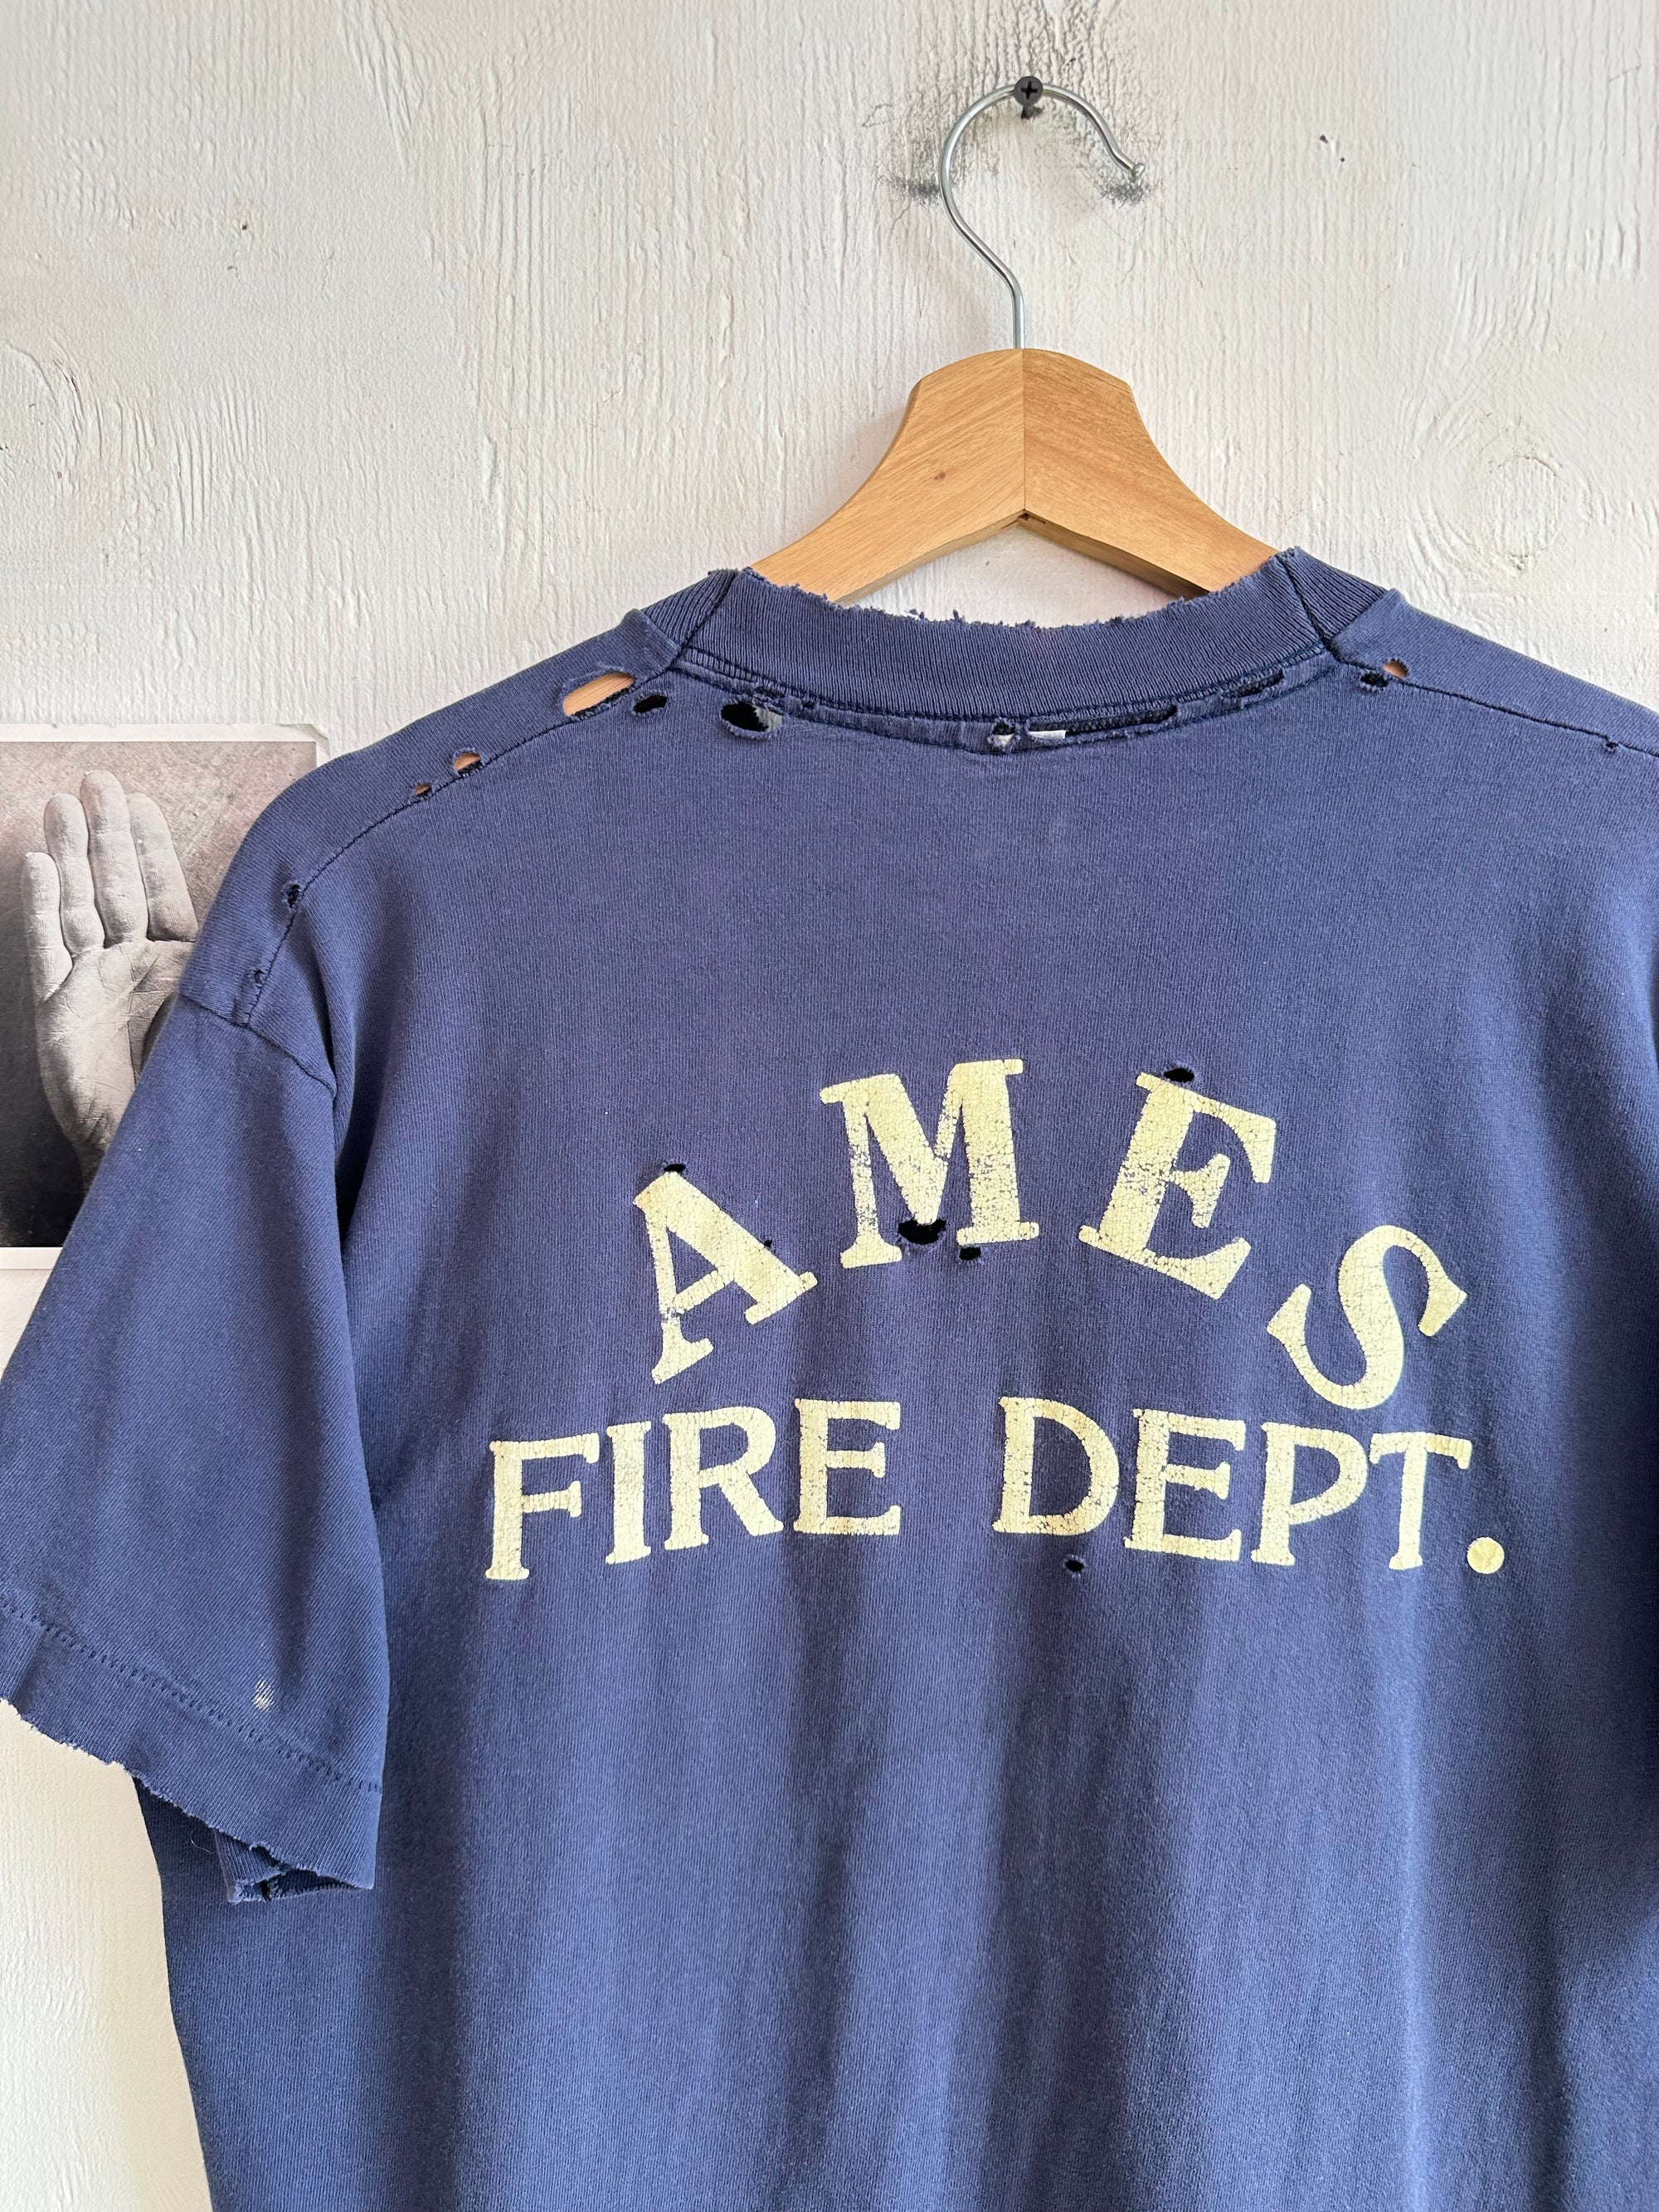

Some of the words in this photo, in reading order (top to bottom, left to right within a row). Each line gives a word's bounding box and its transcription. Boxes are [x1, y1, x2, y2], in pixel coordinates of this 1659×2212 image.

[633, 1057, 1467, 1411] AMES
[484, 1398, 902, 1581] FIRE
[992, 1396, 1506, 1574] DEPT.
